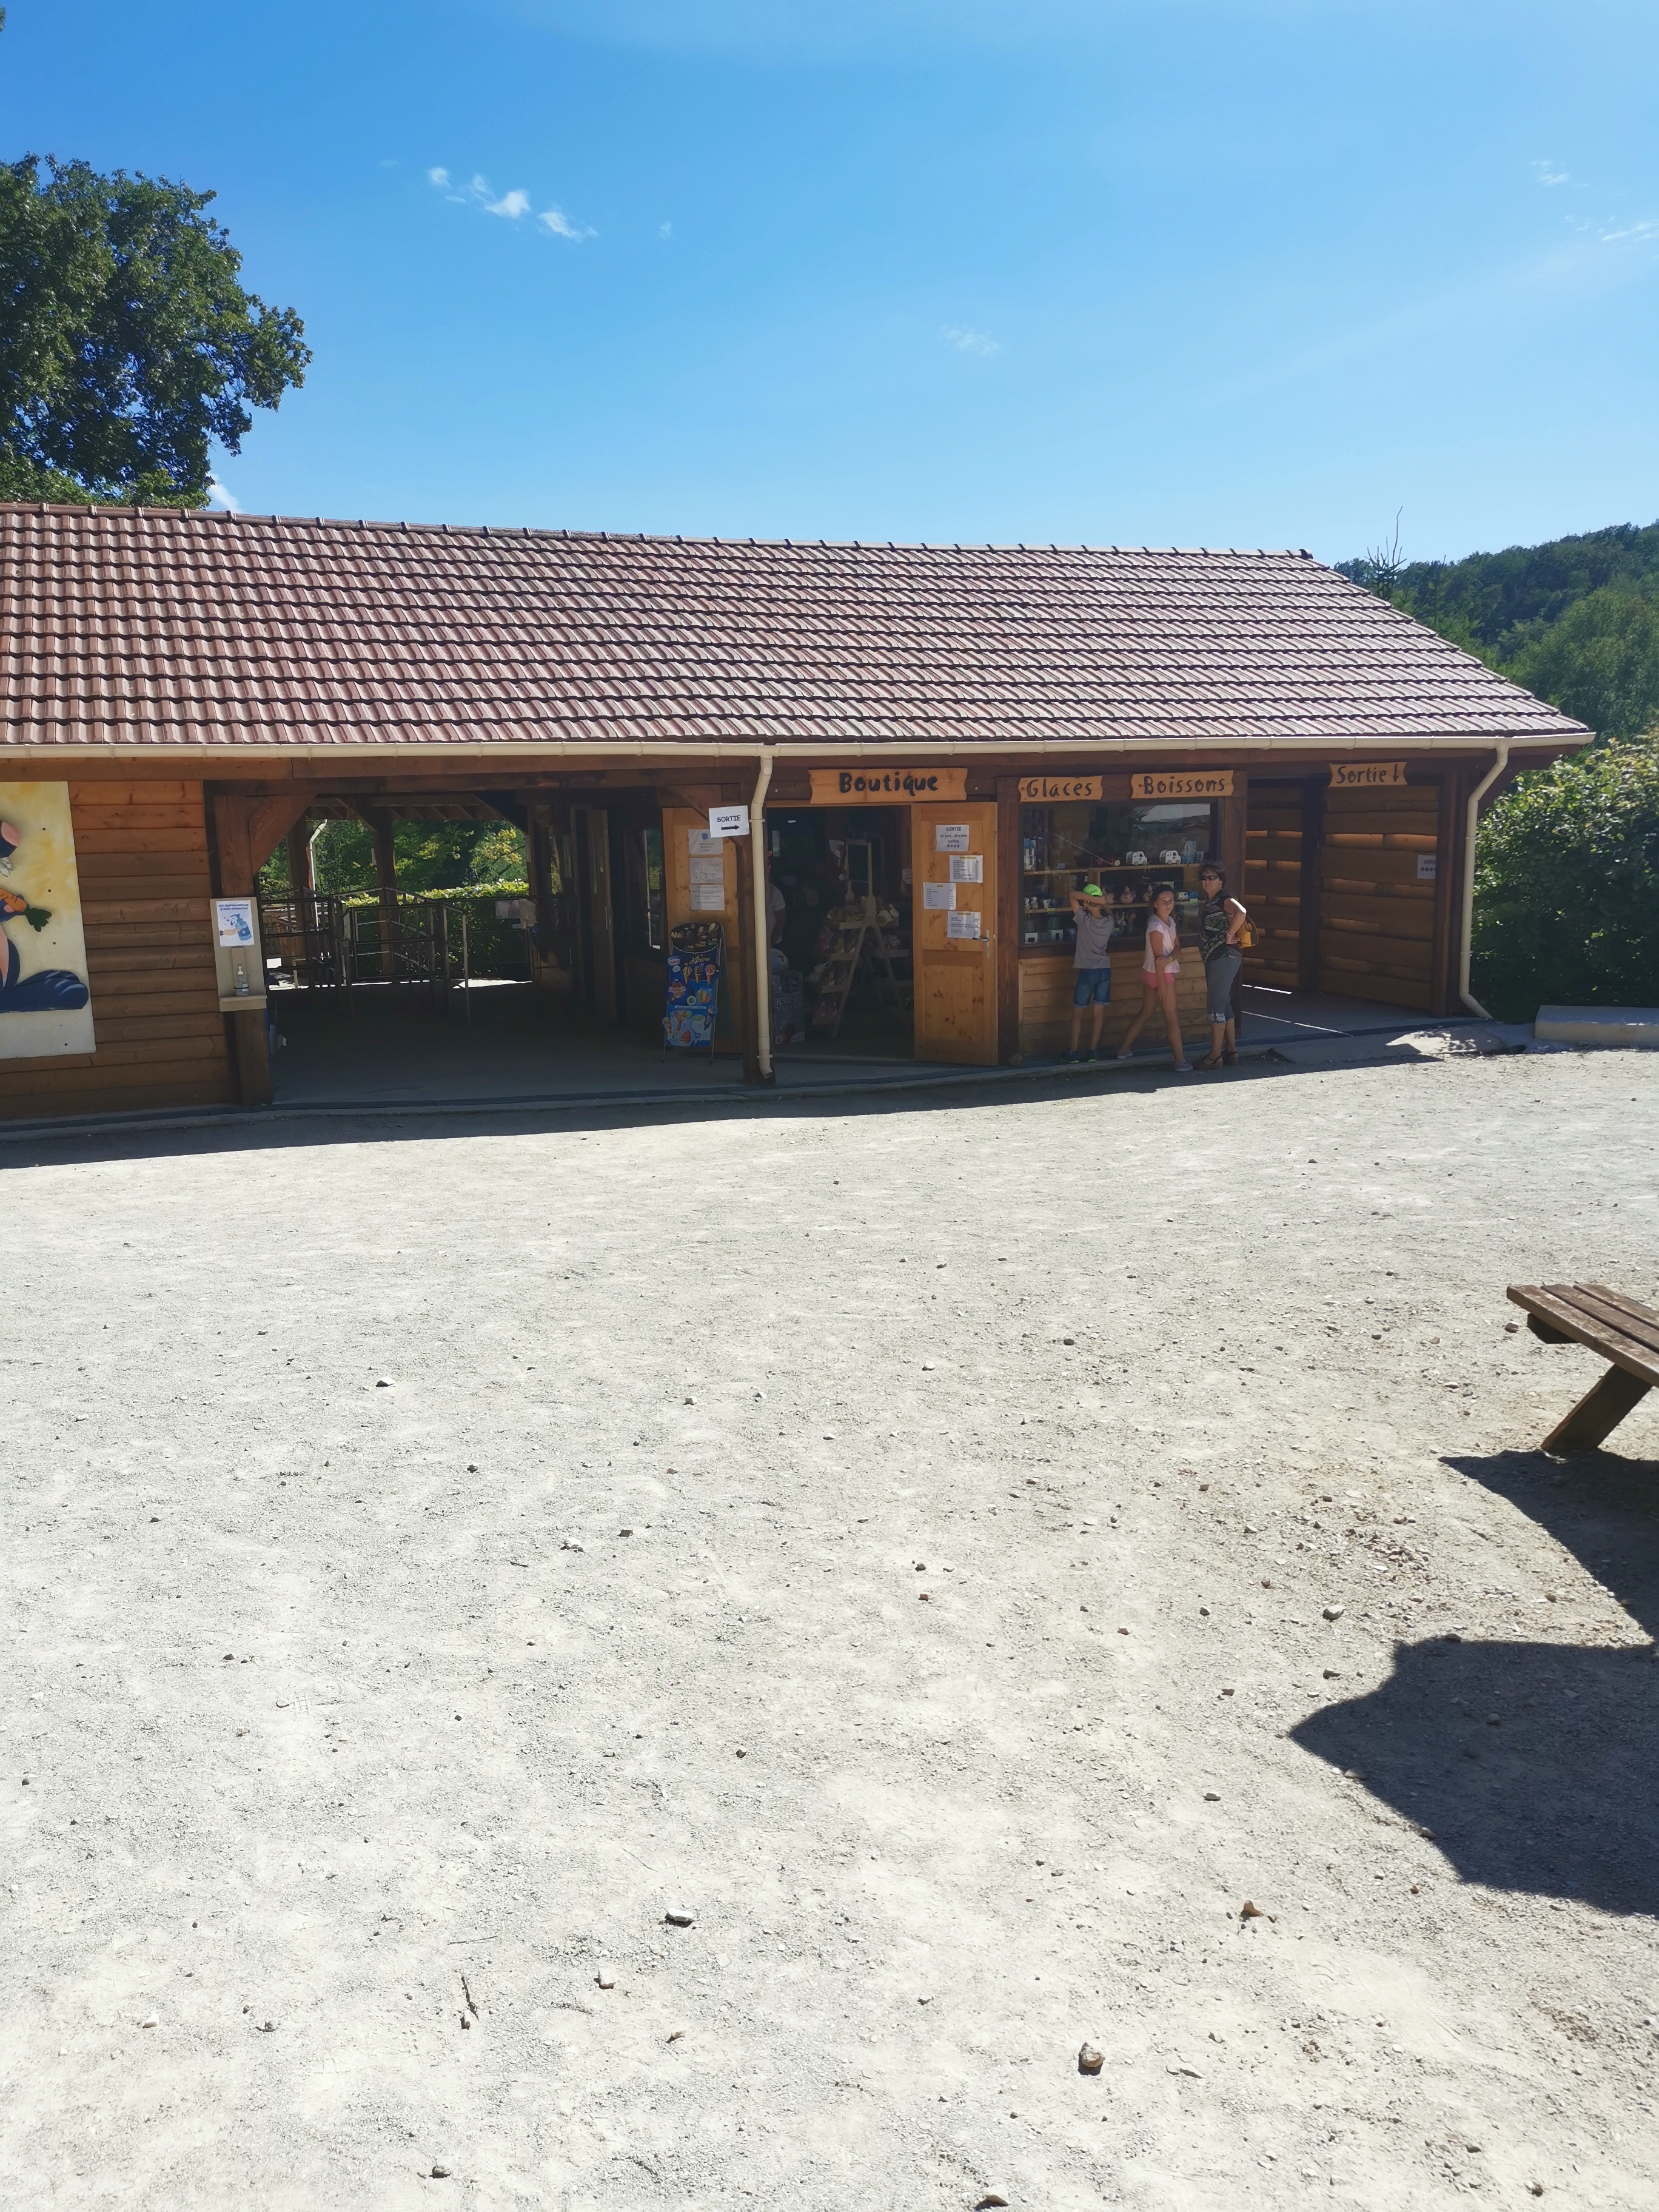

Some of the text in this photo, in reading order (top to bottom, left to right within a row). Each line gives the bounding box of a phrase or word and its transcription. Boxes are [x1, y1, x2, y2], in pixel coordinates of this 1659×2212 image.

[839, 771, 938, 796] Boutique
[1336, 766, 1387, 784] Sortie
[1027, 778, 1092, 797] Glaces
[1144, 776, 1225, 795] Boissons
